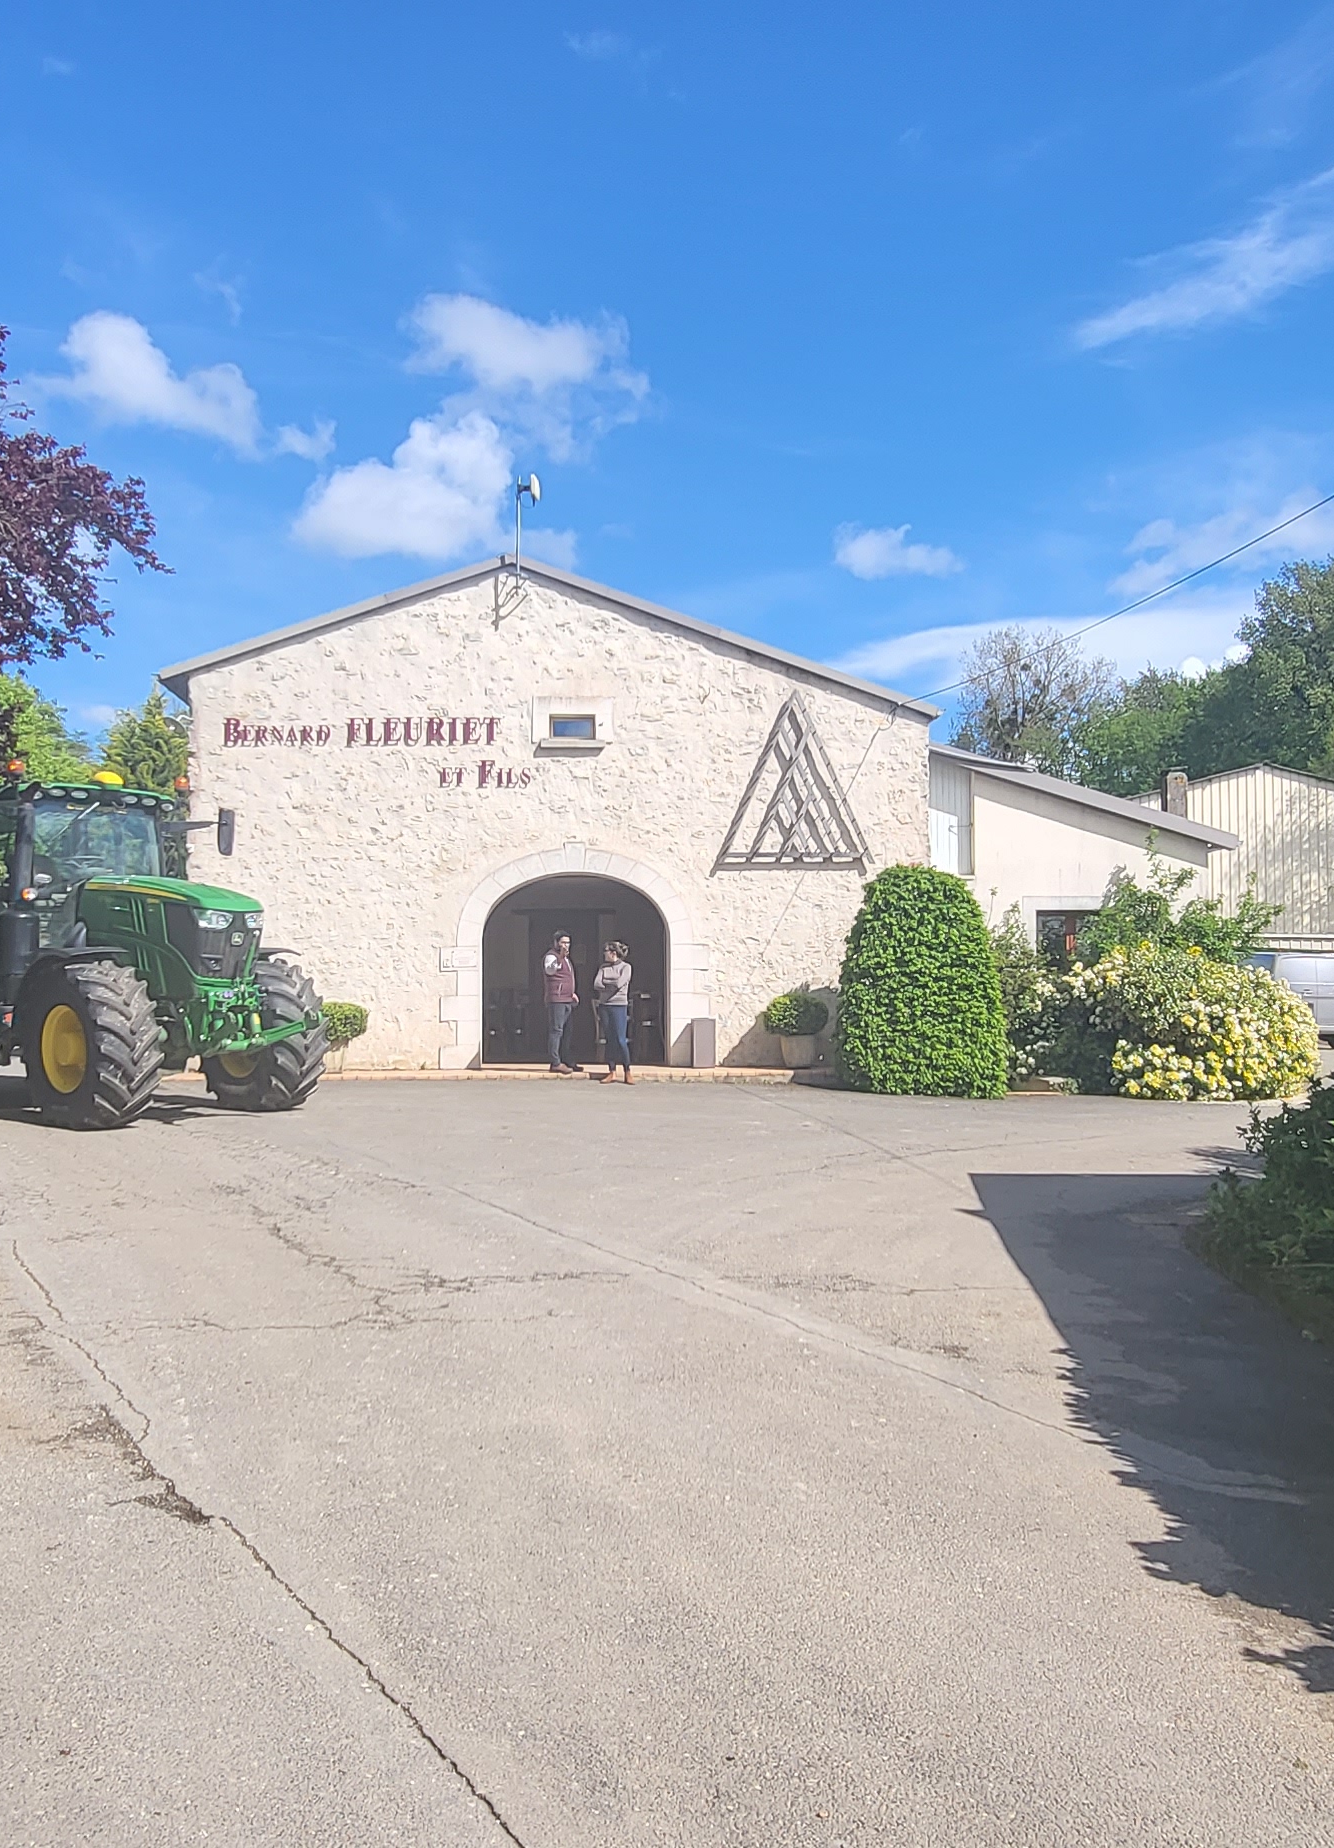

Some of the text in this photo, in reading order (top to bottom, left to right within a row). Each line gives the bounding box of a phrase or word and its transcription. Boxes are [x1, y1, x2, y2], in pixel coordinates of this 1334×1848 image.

[223, 716, 500, 746] BERNARD FLEURIET
[438, 759, 531, 788] ET FILS
